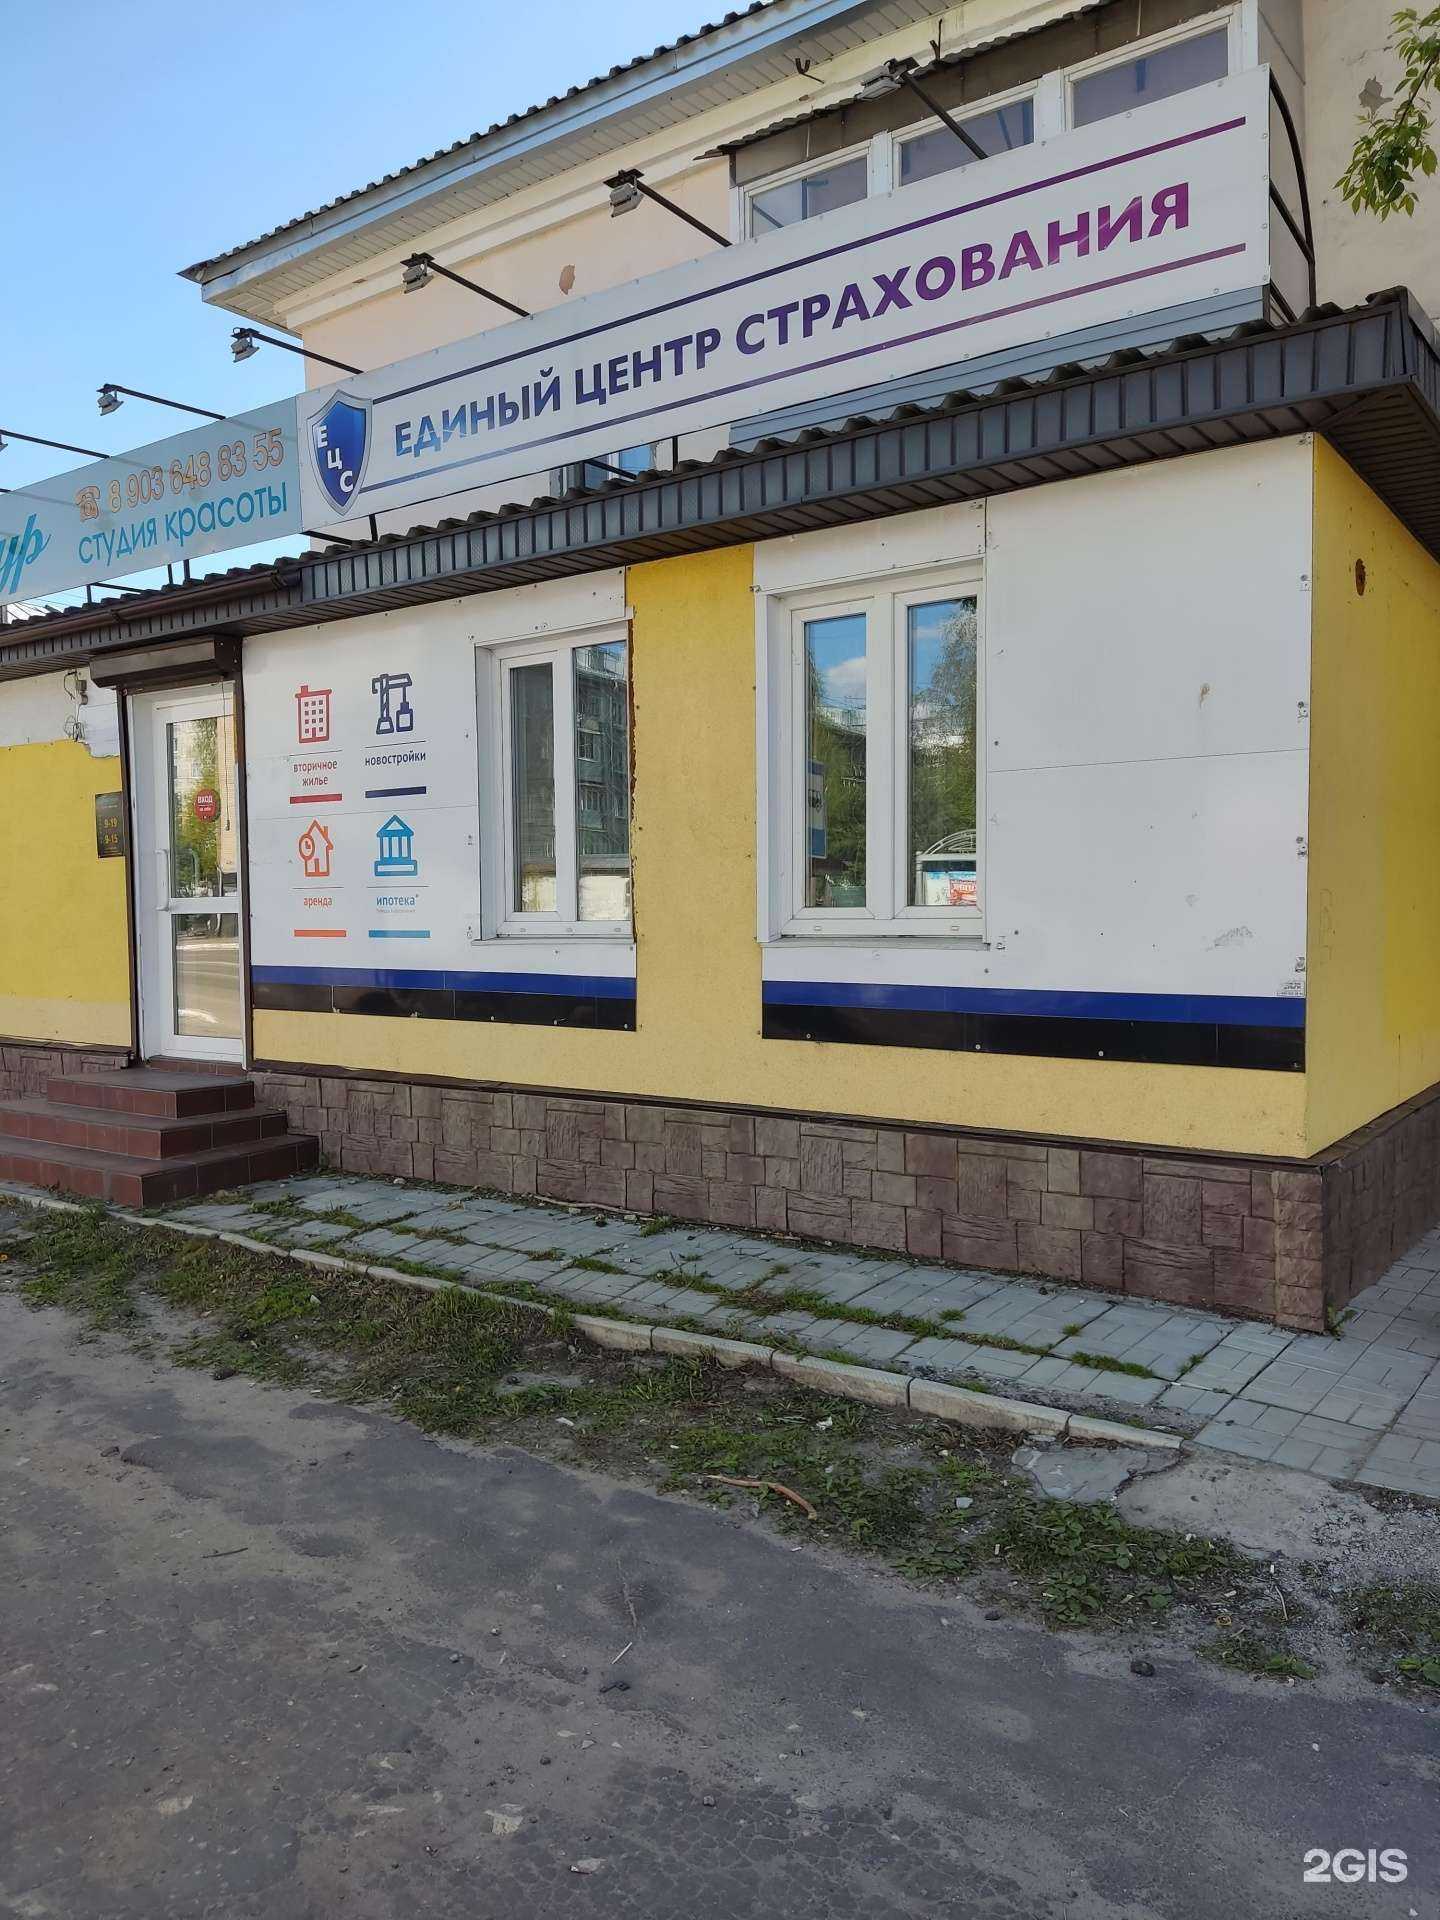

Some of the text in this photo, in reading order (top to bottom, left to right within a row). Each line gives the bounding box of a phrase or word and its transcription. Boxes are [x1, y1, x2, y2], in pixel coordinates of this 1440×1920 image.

[394, 182, 1190, 459] ЕДИНЫЙ ЦЕНТР СТРАХОВАНИЯ
[109, 479, 122, 514] 8
[127, 465, 165, 509] 903
[217, 440, 247, 482] 83
[252, 427, 284, 472] 55
[78, 481, 288, 567] студия красоты
[365, 751, 426, 766] новостройки
[293, 760, 338, 774] вторичное
[302, 775, 329, 787] жилье
[303, 895, 333, 908] аренда
